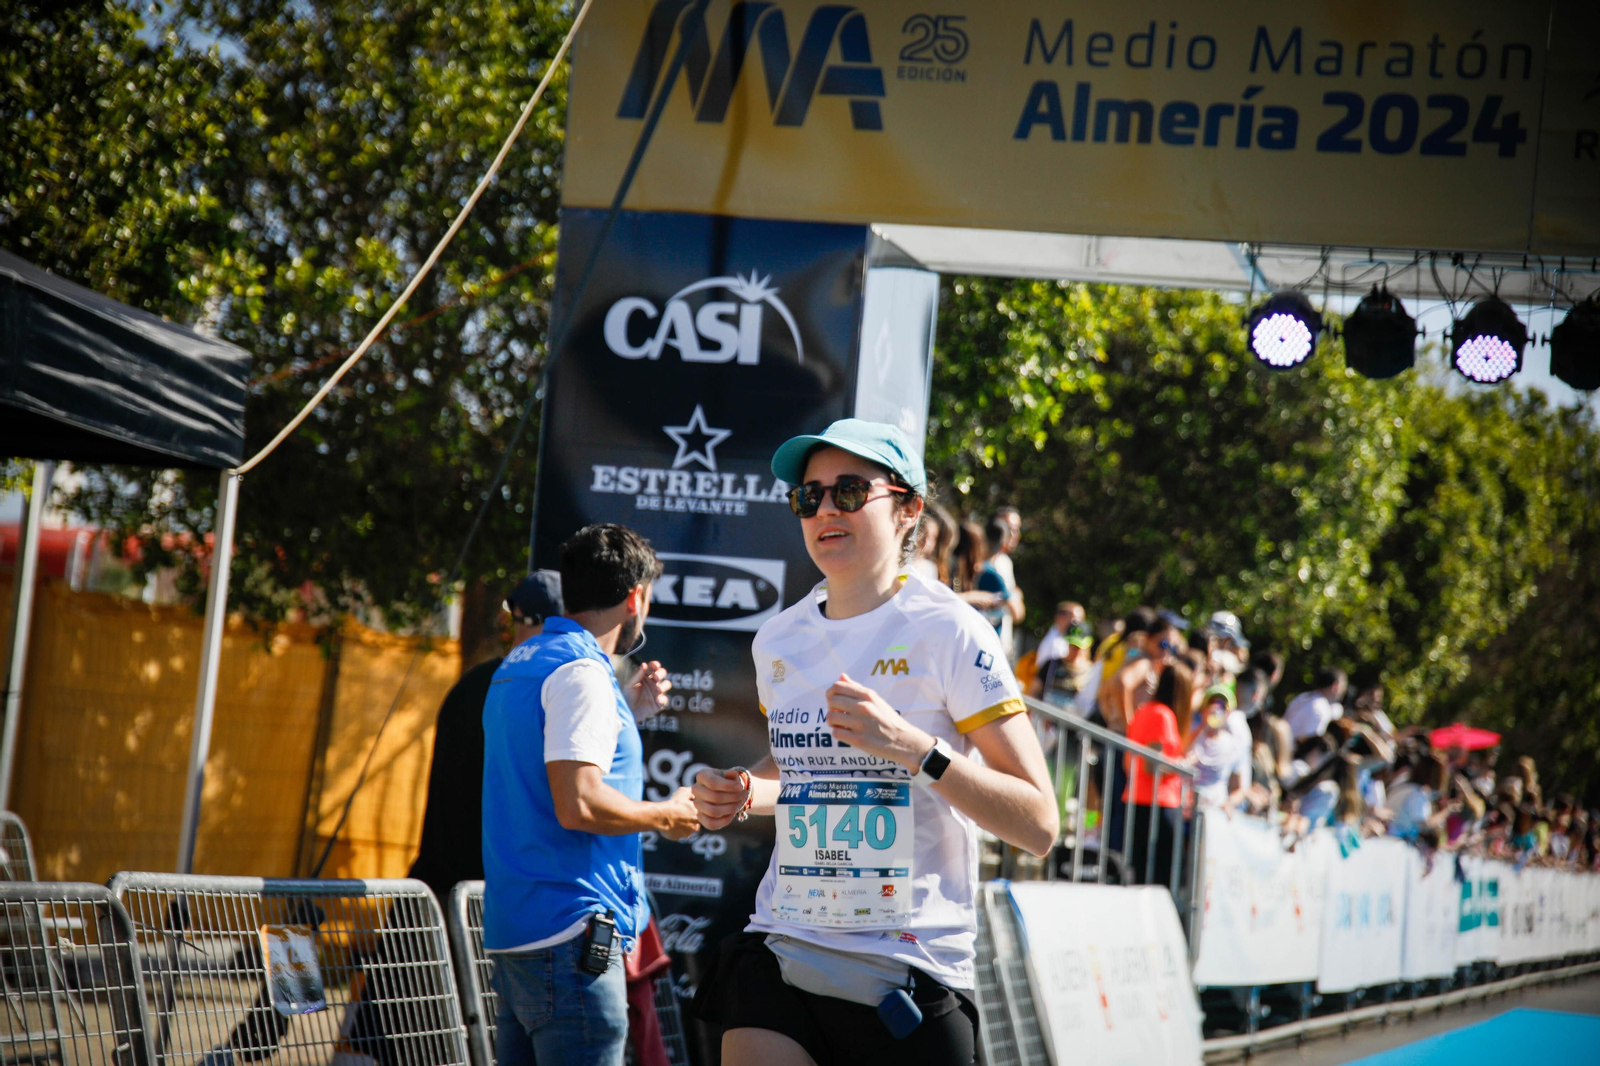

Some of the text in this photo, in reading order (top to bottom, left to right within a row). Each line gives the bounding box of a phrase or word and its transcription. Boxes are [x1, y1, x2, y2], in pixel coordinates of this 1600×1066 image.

[899, 13, 970, 65] 25
[1023, 18, 1533, 81] Medio Maratón
[896, 63, 967, 83] EDICIÓN
[1013, 79, 1527, 158] Almería 2024
[603, 296, 763, 365] CASI
[590, 464, 791, 503] ESTRELLA
[635, 494, 748, 516] DE LEVANTE
[650, 573, 760, 611] KEA
[770, 726, 833, 748] Almería
[807, 756, 837, 766] RUIZ
[808, 790, 858, 799] Almería 2024
[788, 805, 897, 850] 5140
[815, 849, 852, 861] ISABEL
